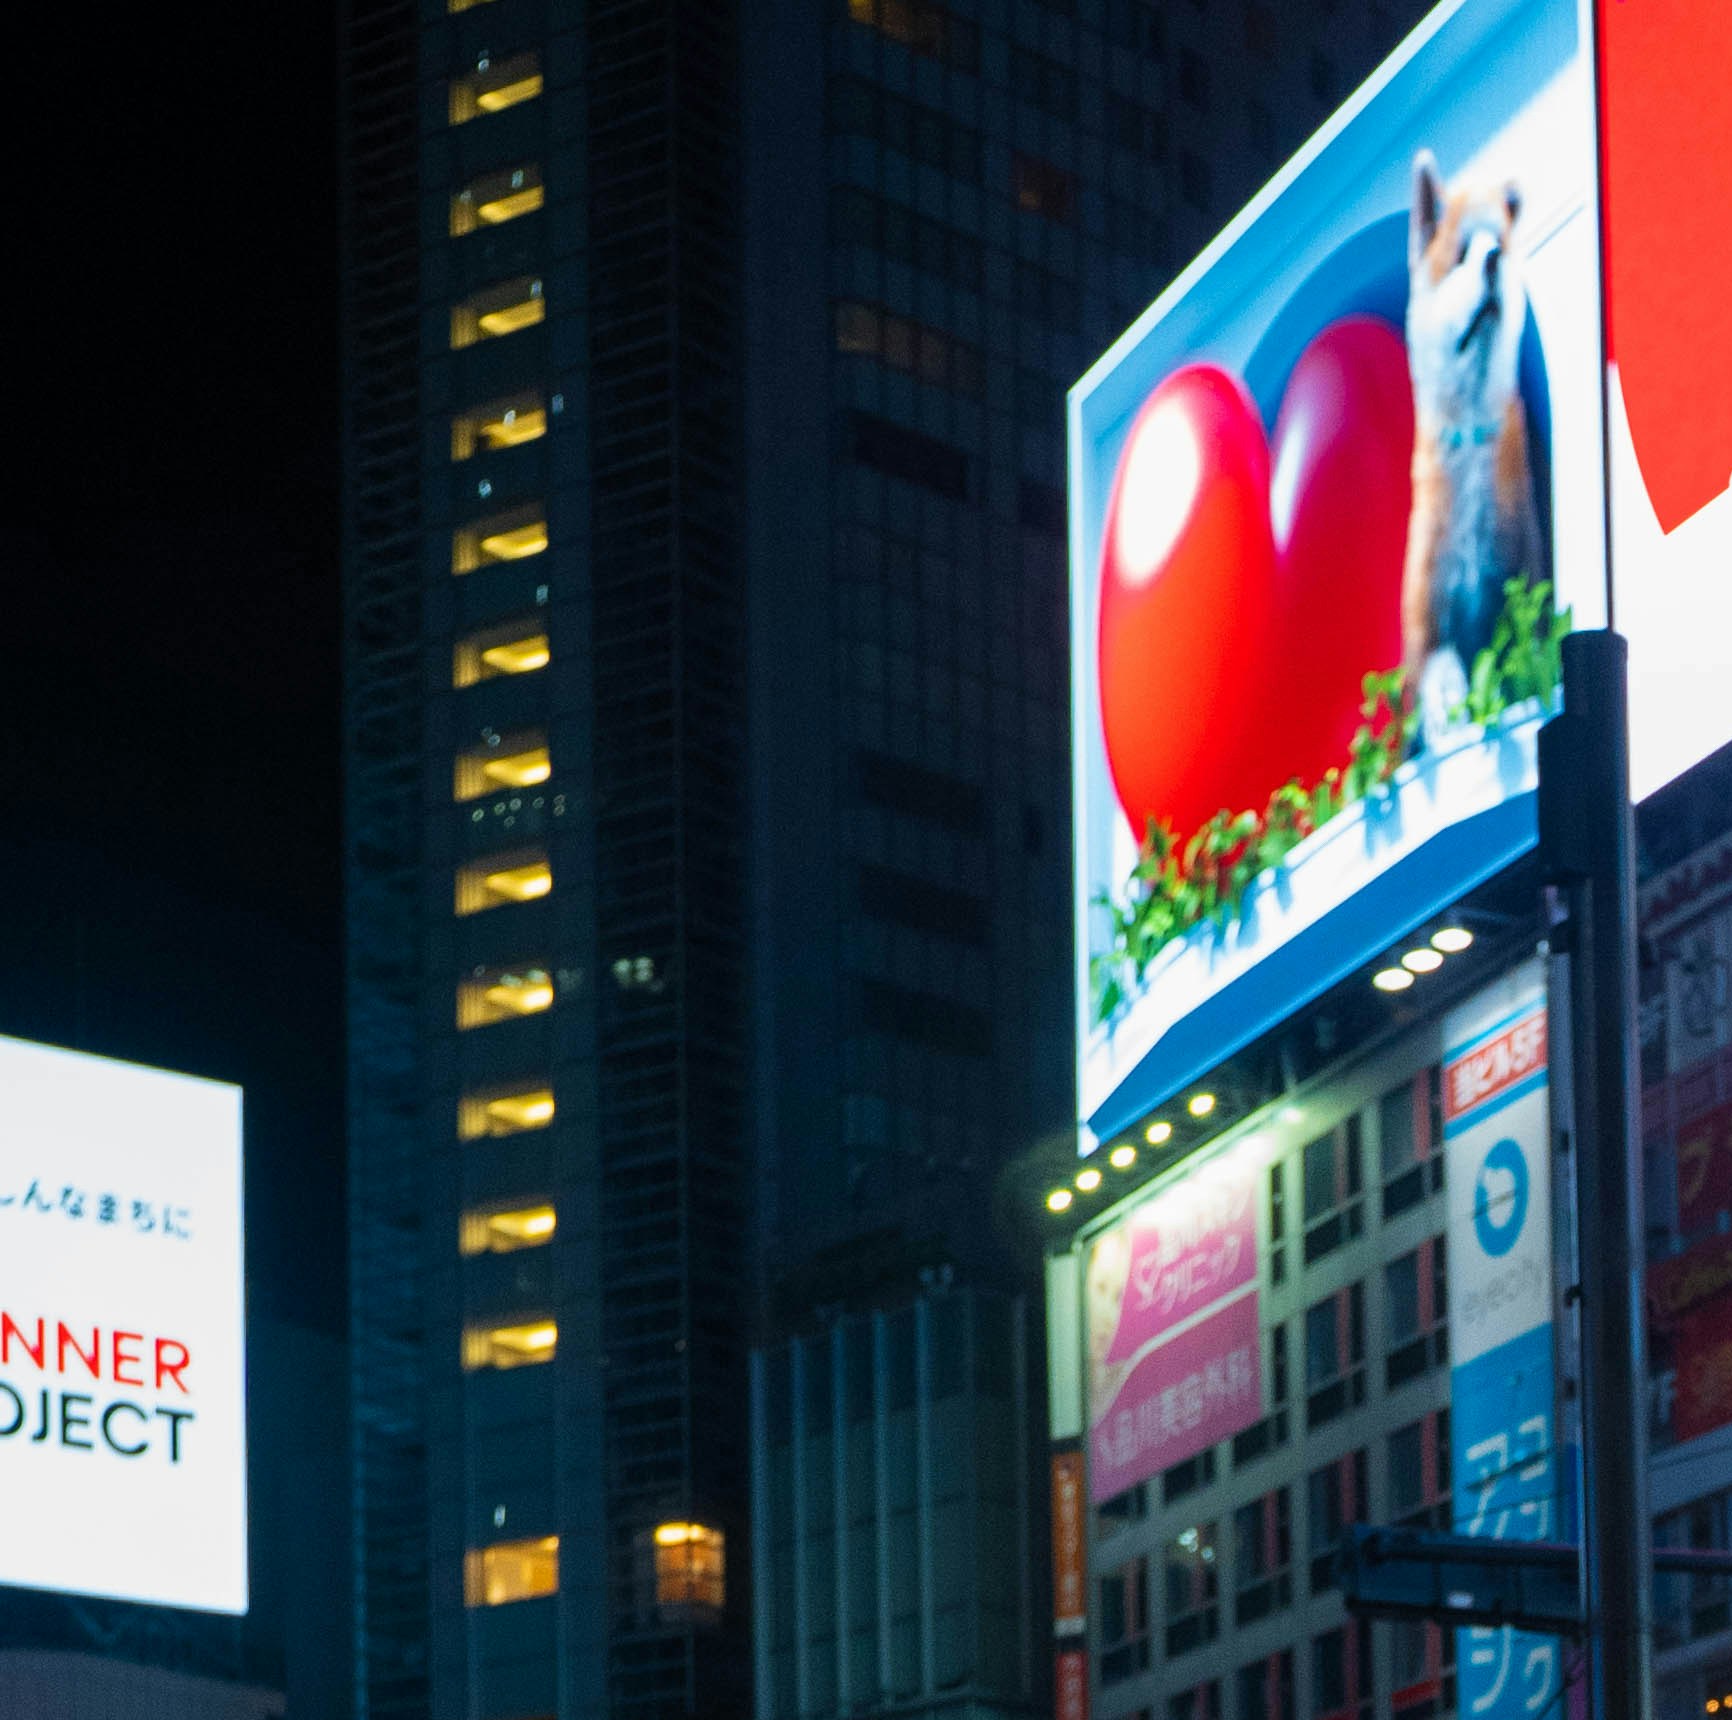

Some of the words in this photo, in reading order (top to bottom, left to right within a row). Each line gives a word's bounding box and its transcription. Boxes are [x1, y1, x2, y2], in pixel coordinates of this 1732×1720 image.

[0, 1178, 192, 1241] んなまちに
[1, 1310, 191, 1394] NNER
